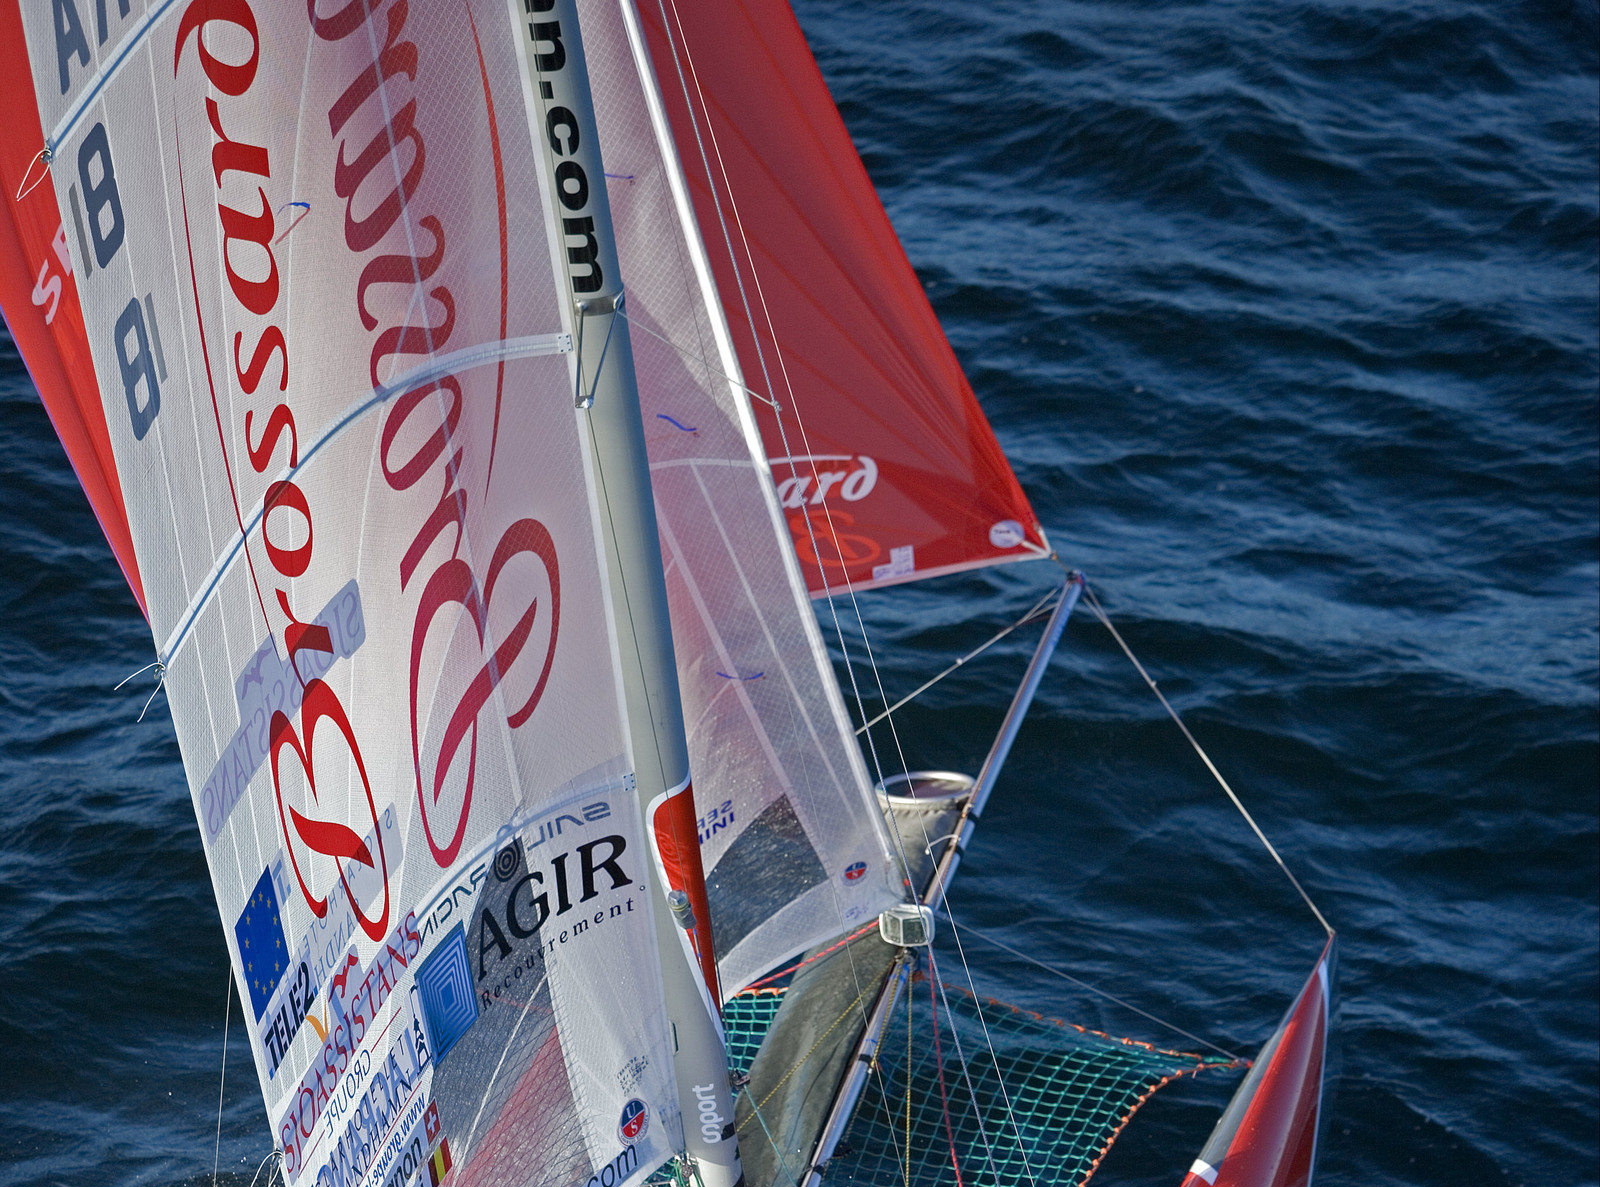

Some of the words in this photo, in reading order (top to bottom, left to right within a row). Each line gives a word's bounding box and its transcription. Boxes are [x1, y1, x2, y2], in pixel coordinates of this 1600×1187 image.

[524, 0, 603, 293] n.com
[477, 833, 634, 982] AGIR
[481, 898, 635, 1012] Recouvrement
[264, 961, 316, 1078] TELE2
[281, 911, 420, 1176] SJÖASSISTANS
[692, 1083, 724, 1144] sport
